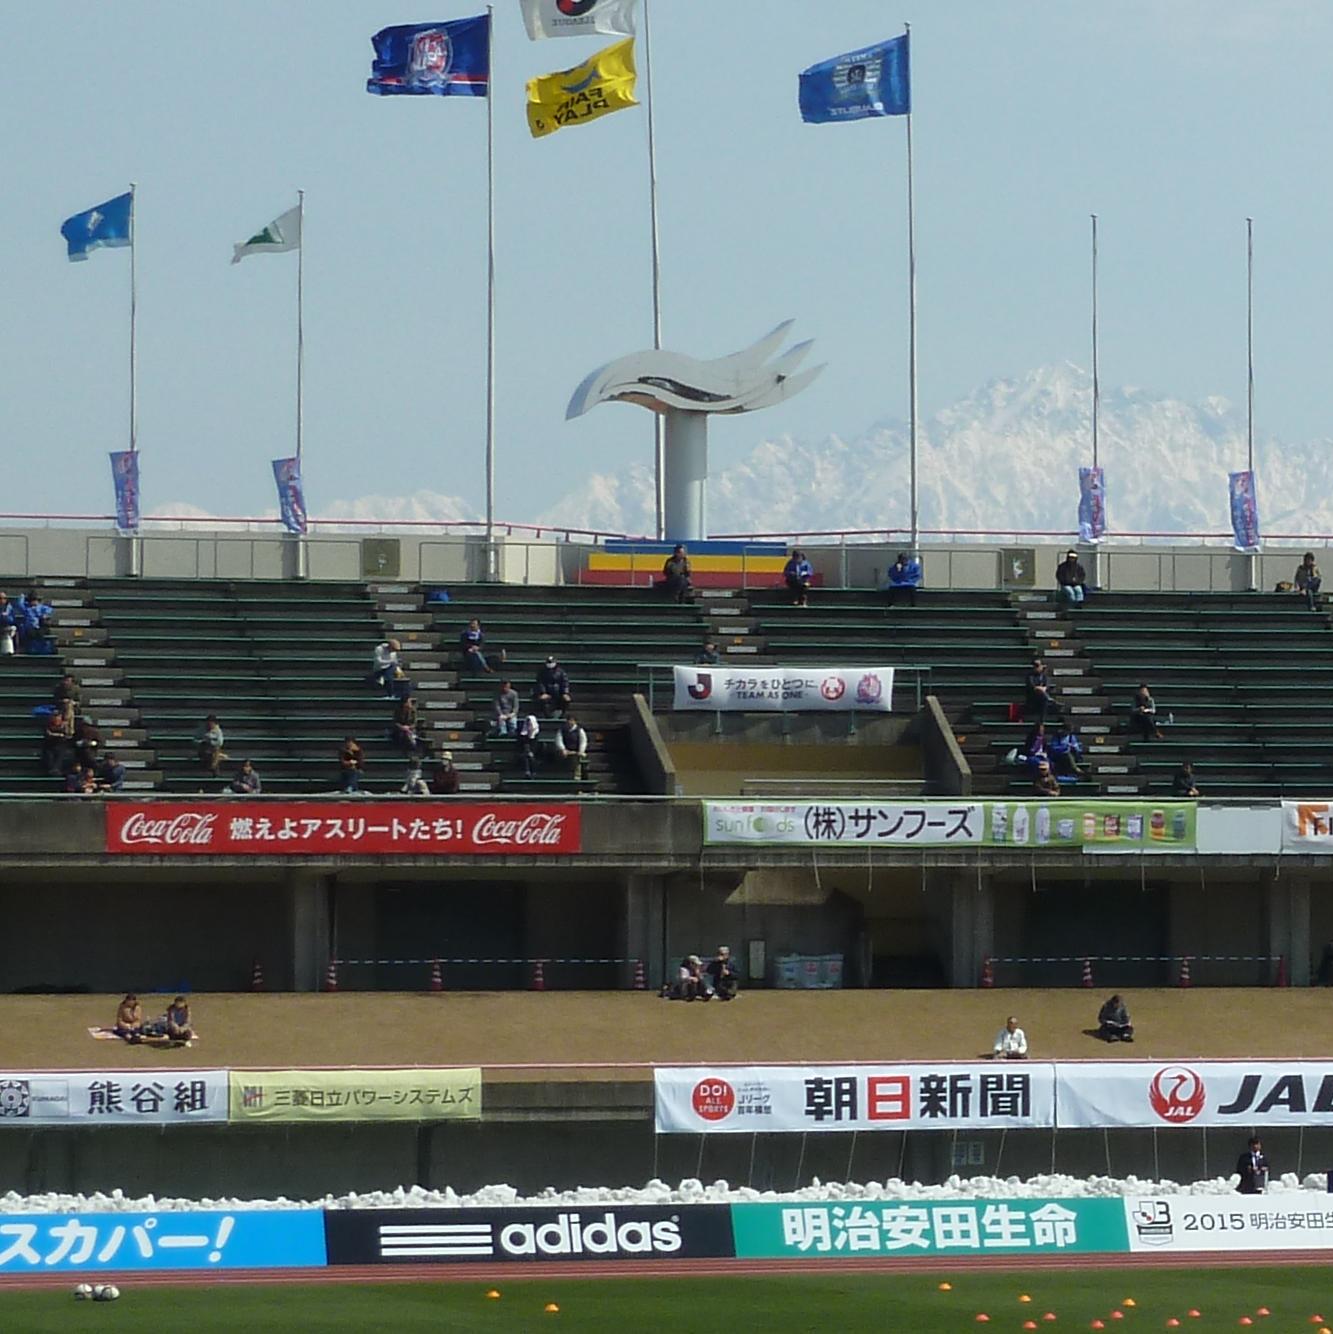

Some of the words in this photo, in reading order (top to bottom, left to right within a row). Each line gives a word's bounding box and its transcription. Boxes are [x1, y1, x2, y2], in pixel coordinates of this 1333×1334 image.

[87, 1080, 209, 1115] 熊谷組
[274, 1087, 474, 1107] 三菱日立パワーシステムズ
[804, 1073, 1031, 1121] 朝日新聞
[1163, 1106, 1195, 1117] JAL
[501, 1213, 680, 1254] adidas
[781, 1203, 1078, 1252] 明治安田生命
[1183, 1213, 1245, 1231] 2015
